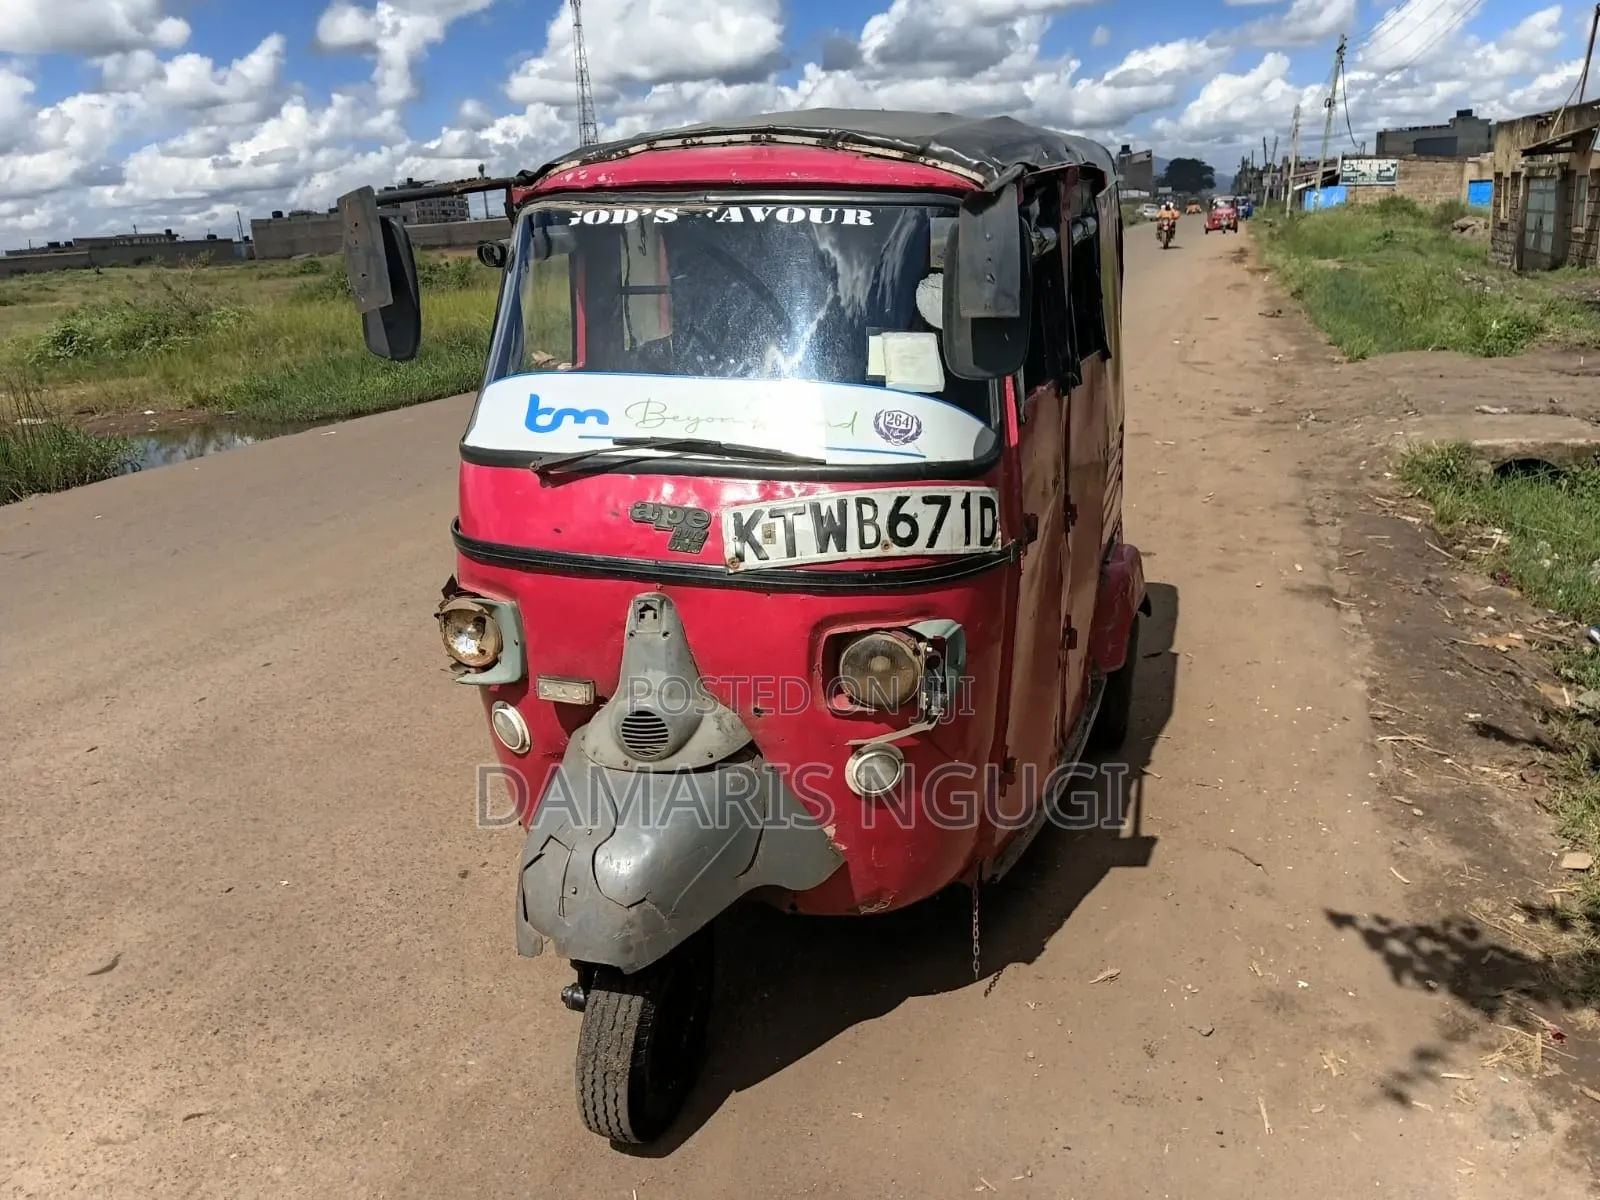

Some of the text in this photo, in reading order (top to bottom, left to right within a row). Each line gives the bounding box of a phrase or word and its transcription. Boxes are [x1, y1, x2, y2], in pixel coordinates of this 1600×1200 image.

[705, 206, 875, 226] AVOUR
[886, 412, 910, 429] 264
[630, 501, 711, 530] ape
